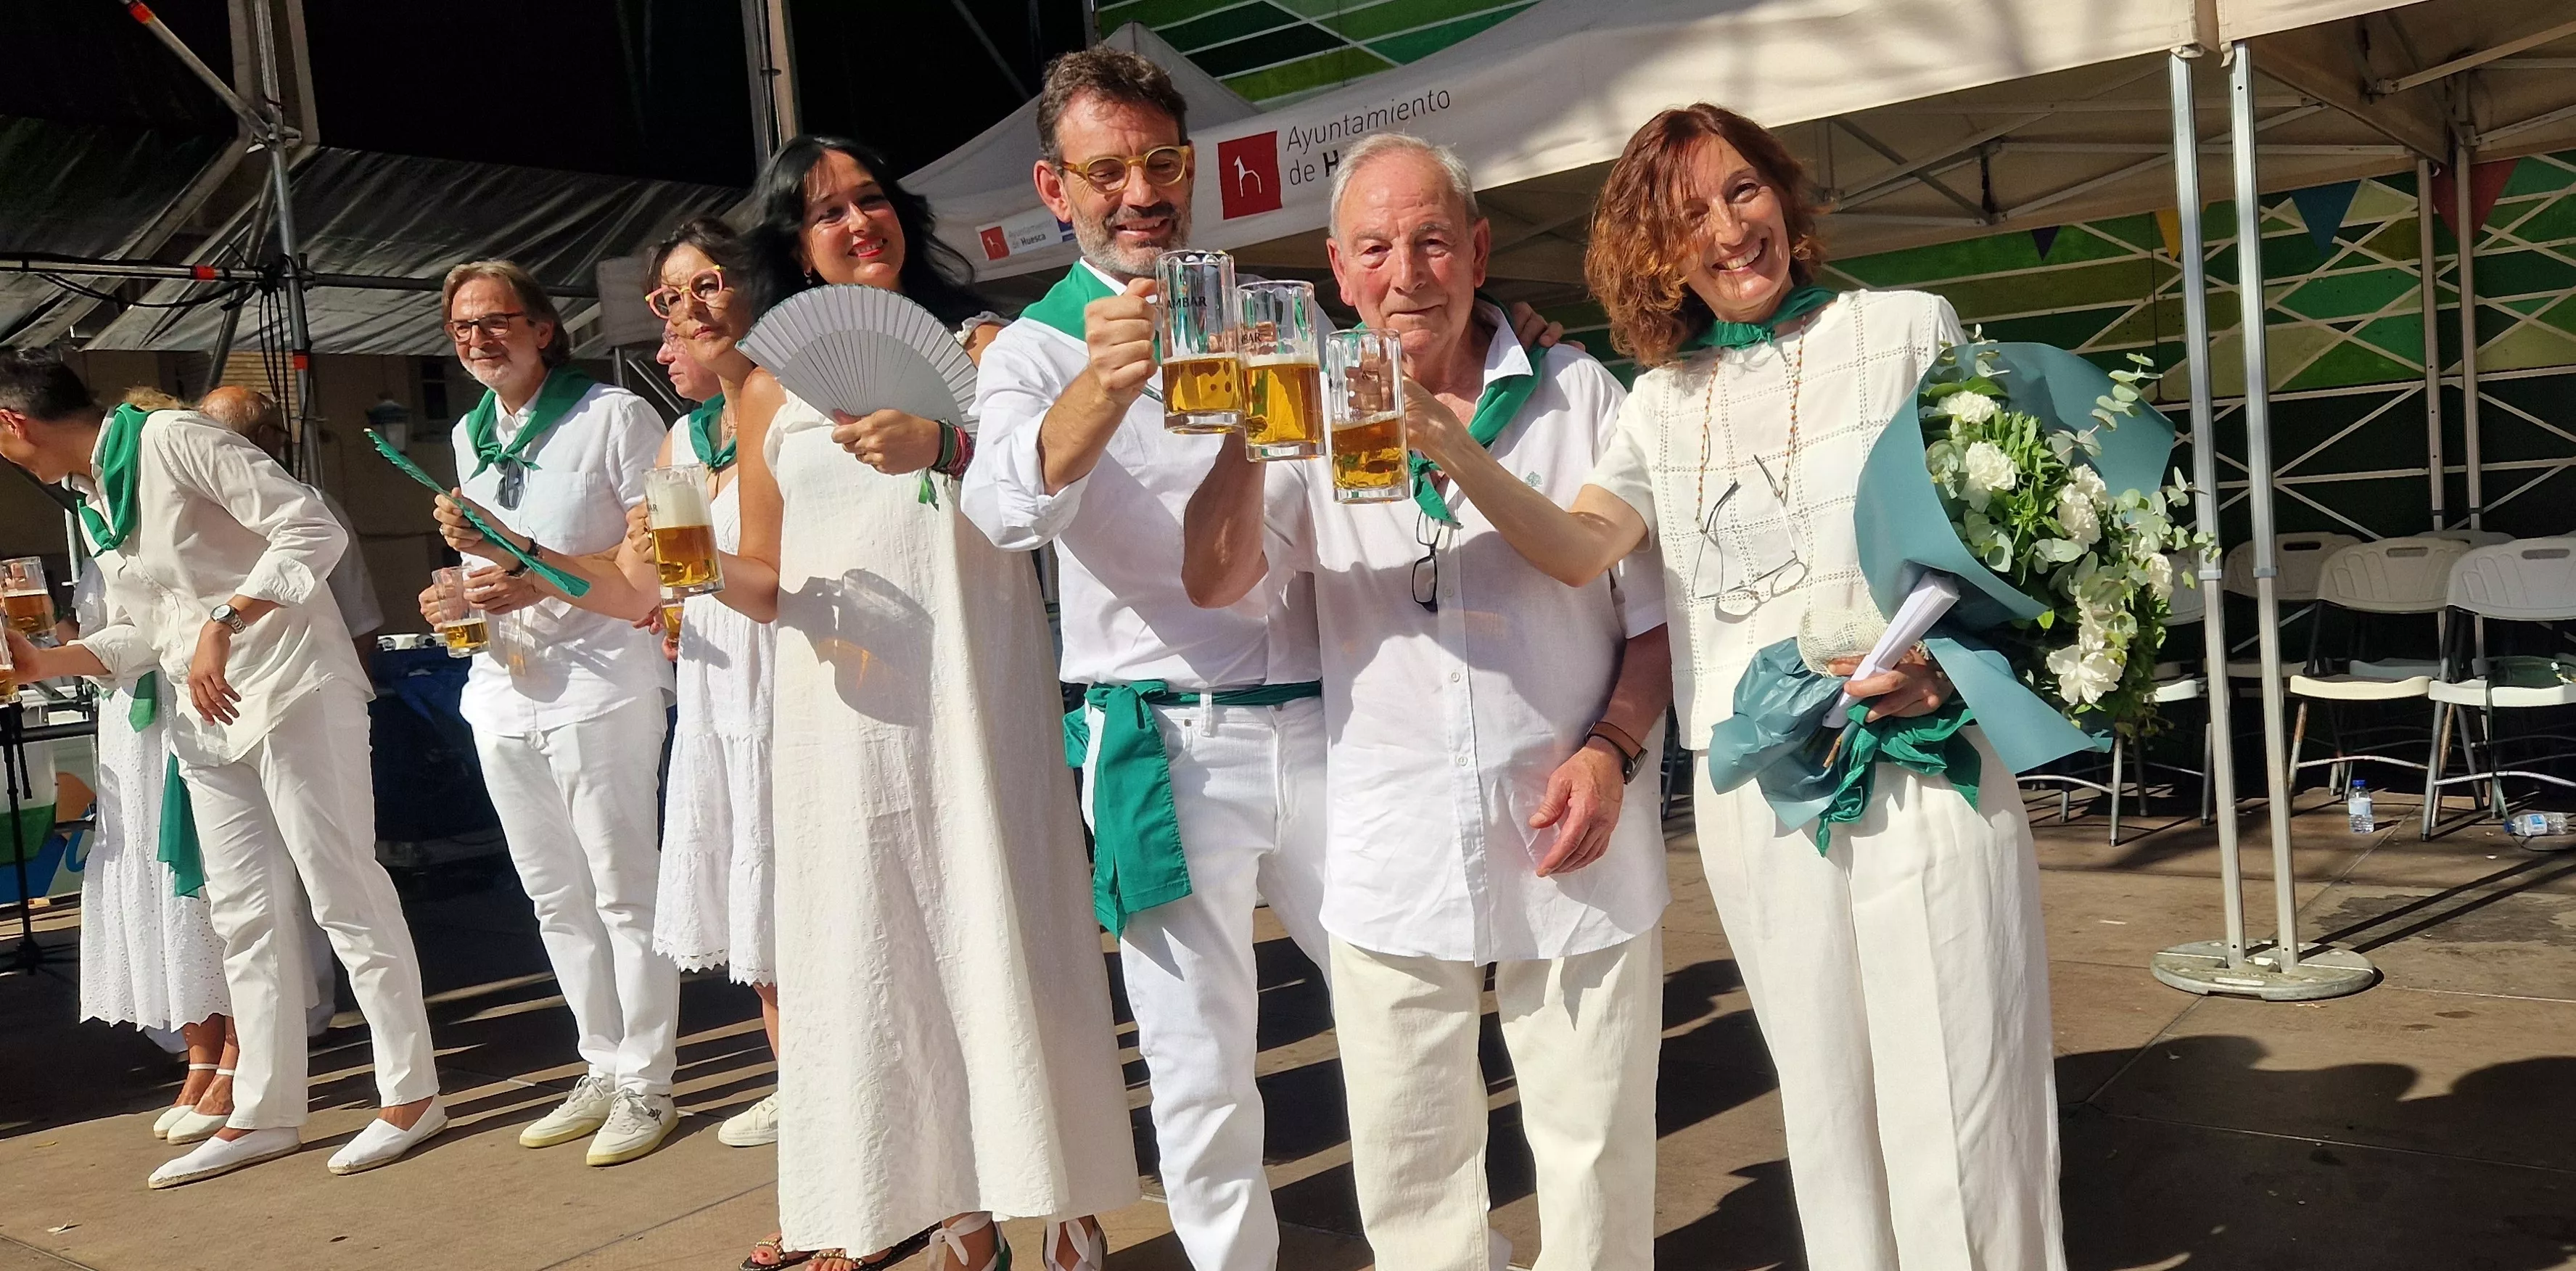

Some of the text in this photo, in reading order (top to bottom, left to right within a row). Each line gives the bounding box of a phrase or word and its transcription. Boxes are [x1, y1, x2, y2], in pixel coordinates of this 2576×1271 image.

[1286, 90, 1450, 155] Ayuntamiento
[1289, 149, 1340, 185] de H
[1021, 233, 1047, 246] Huesca
[1167, 296, 1207, 310] AMBAR
